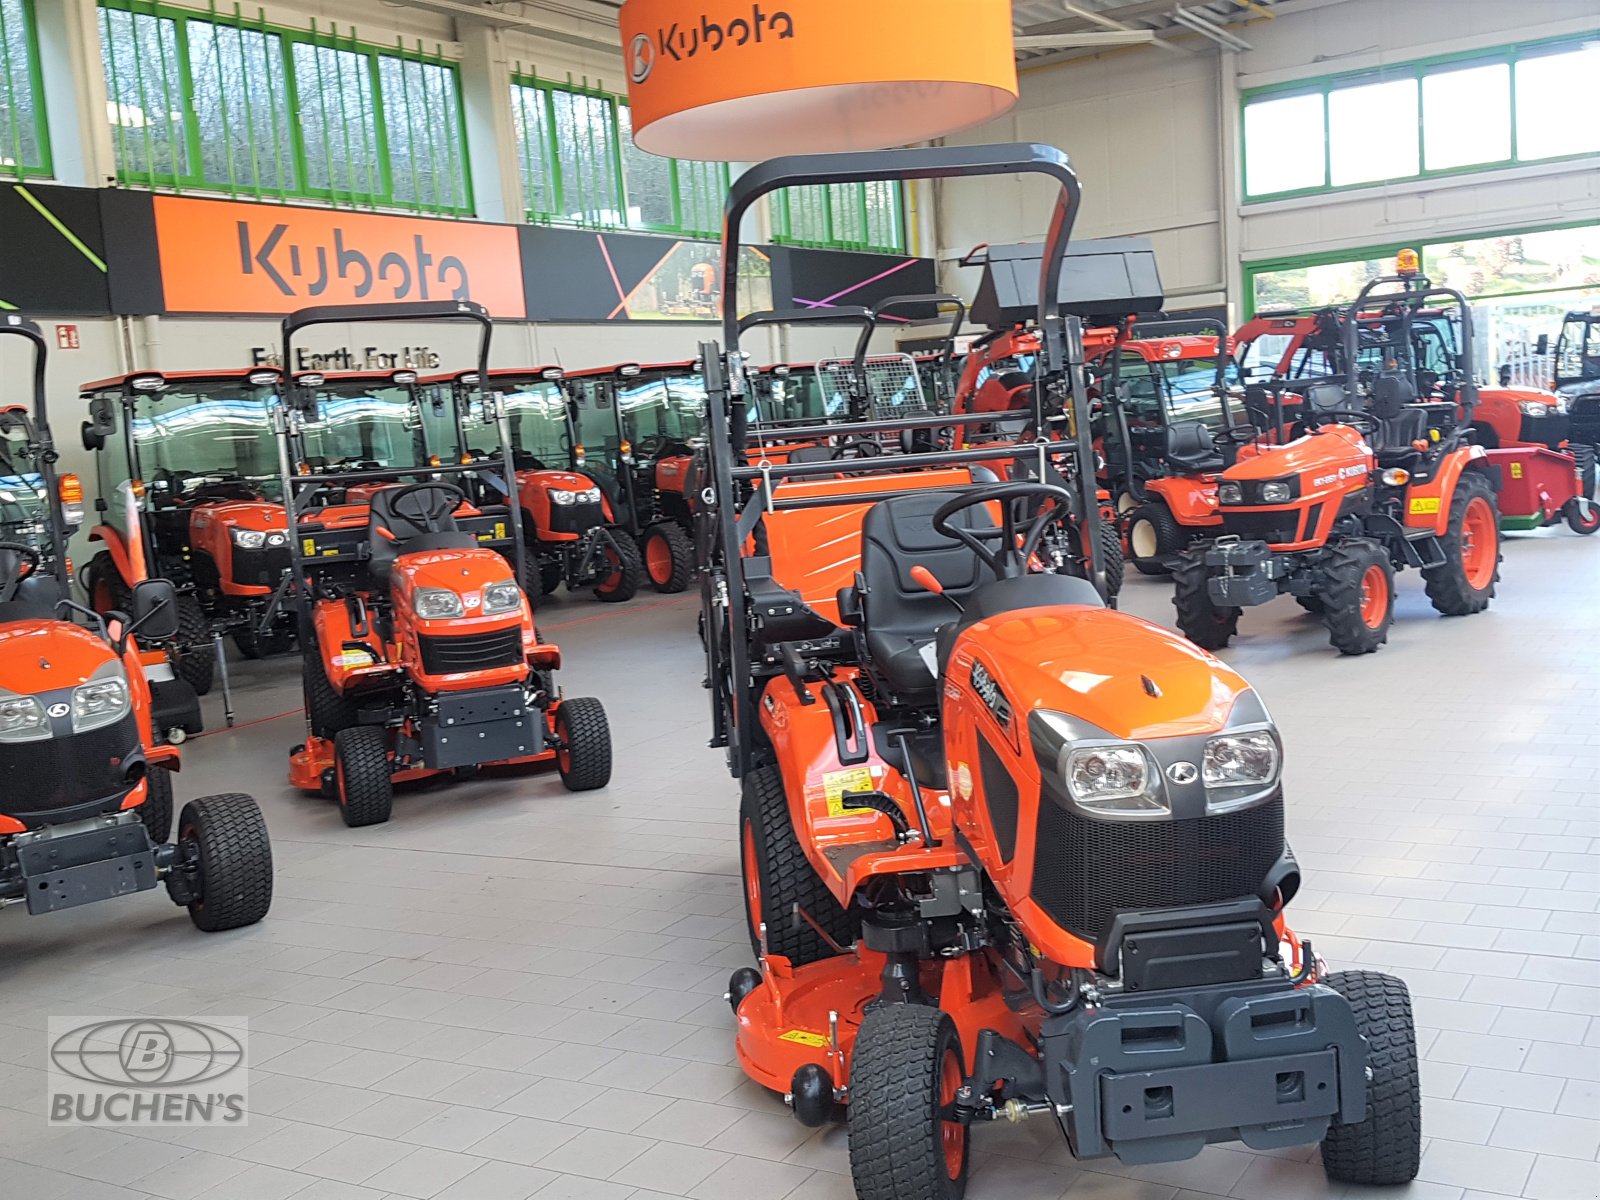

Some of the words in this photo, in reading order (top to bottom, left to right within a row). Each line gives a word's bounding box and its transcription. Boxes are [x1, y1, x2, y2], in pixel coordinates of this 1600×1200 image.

[658, 3, 794, 62] Kubota
[236, 220, 471, 300] Kubota
[365, 347, 397, 369] For
[403, 346, 440, 369] Life
